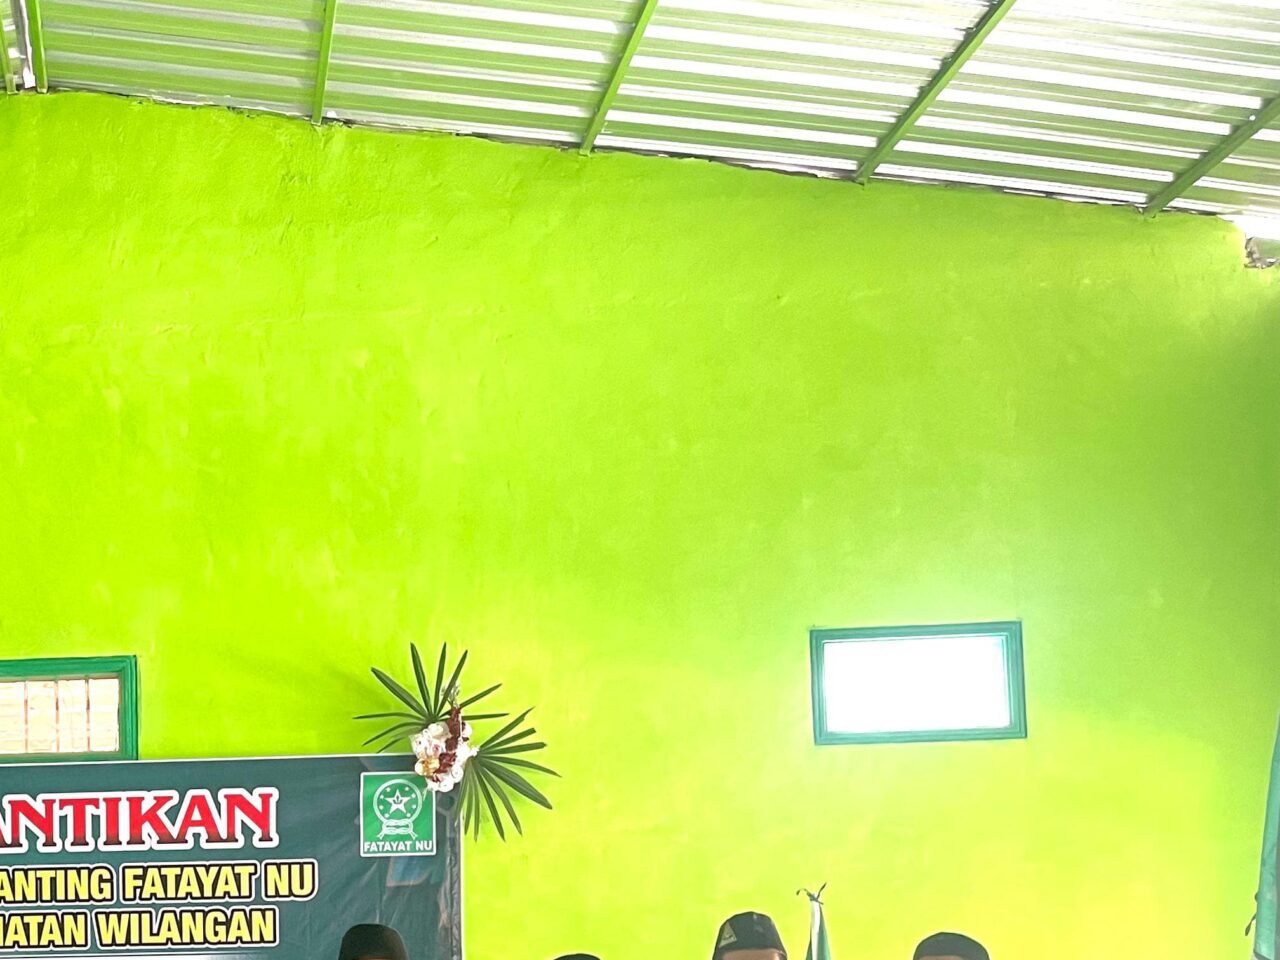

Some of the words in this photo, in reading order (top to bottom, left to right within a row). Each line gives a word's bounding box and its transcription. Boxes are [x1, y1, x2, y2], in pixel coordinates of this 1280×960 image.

[363, 842, 412, 852] FATAYAT
[415, 840, 432, 851] NU
[123, 863, 256, 901] FATAYAT
[264, 861, 317, 898] NU
[96, 909, 276, 947] WILANGAN
